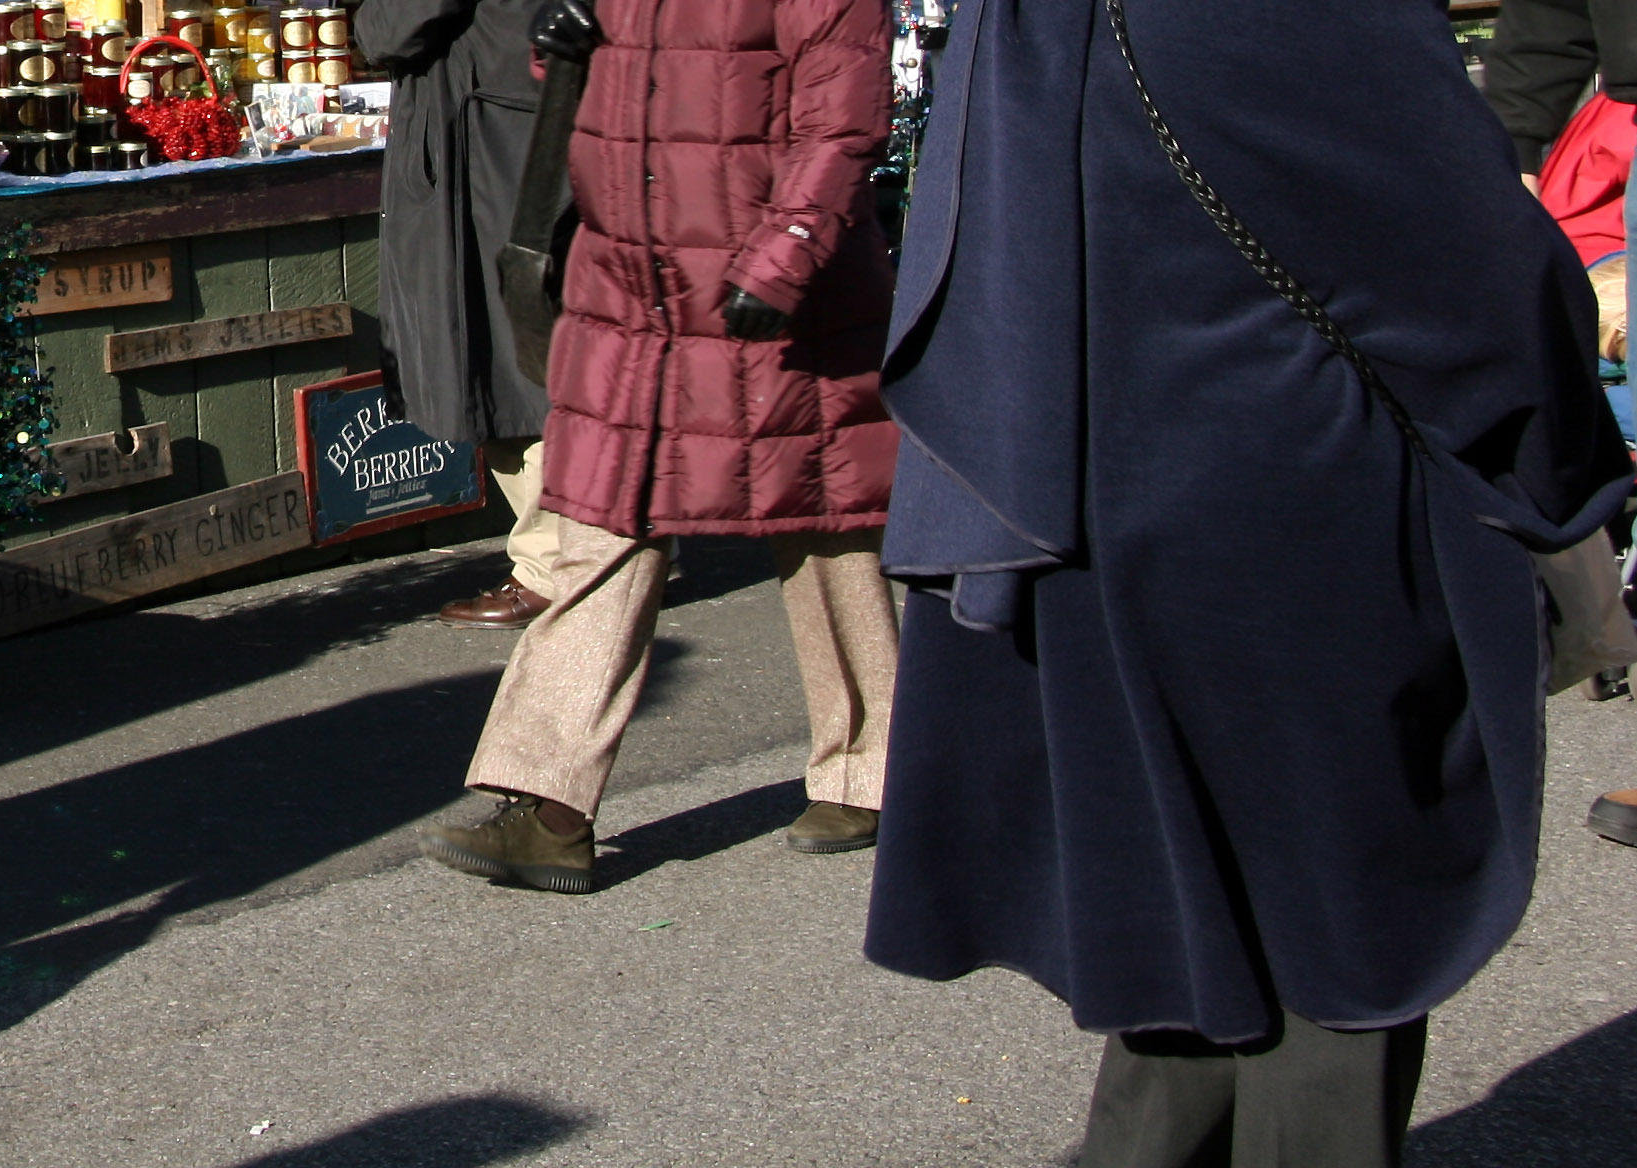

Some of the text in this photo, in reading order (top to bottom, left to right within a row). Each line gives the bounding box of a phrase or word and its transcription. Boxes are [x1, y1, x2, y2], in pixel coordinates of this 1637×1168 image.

[54, 258, 157, 298] SYRUP
[354, 440, 446, 492] BERRIES
[195, 487, 301, 557] GINGER
